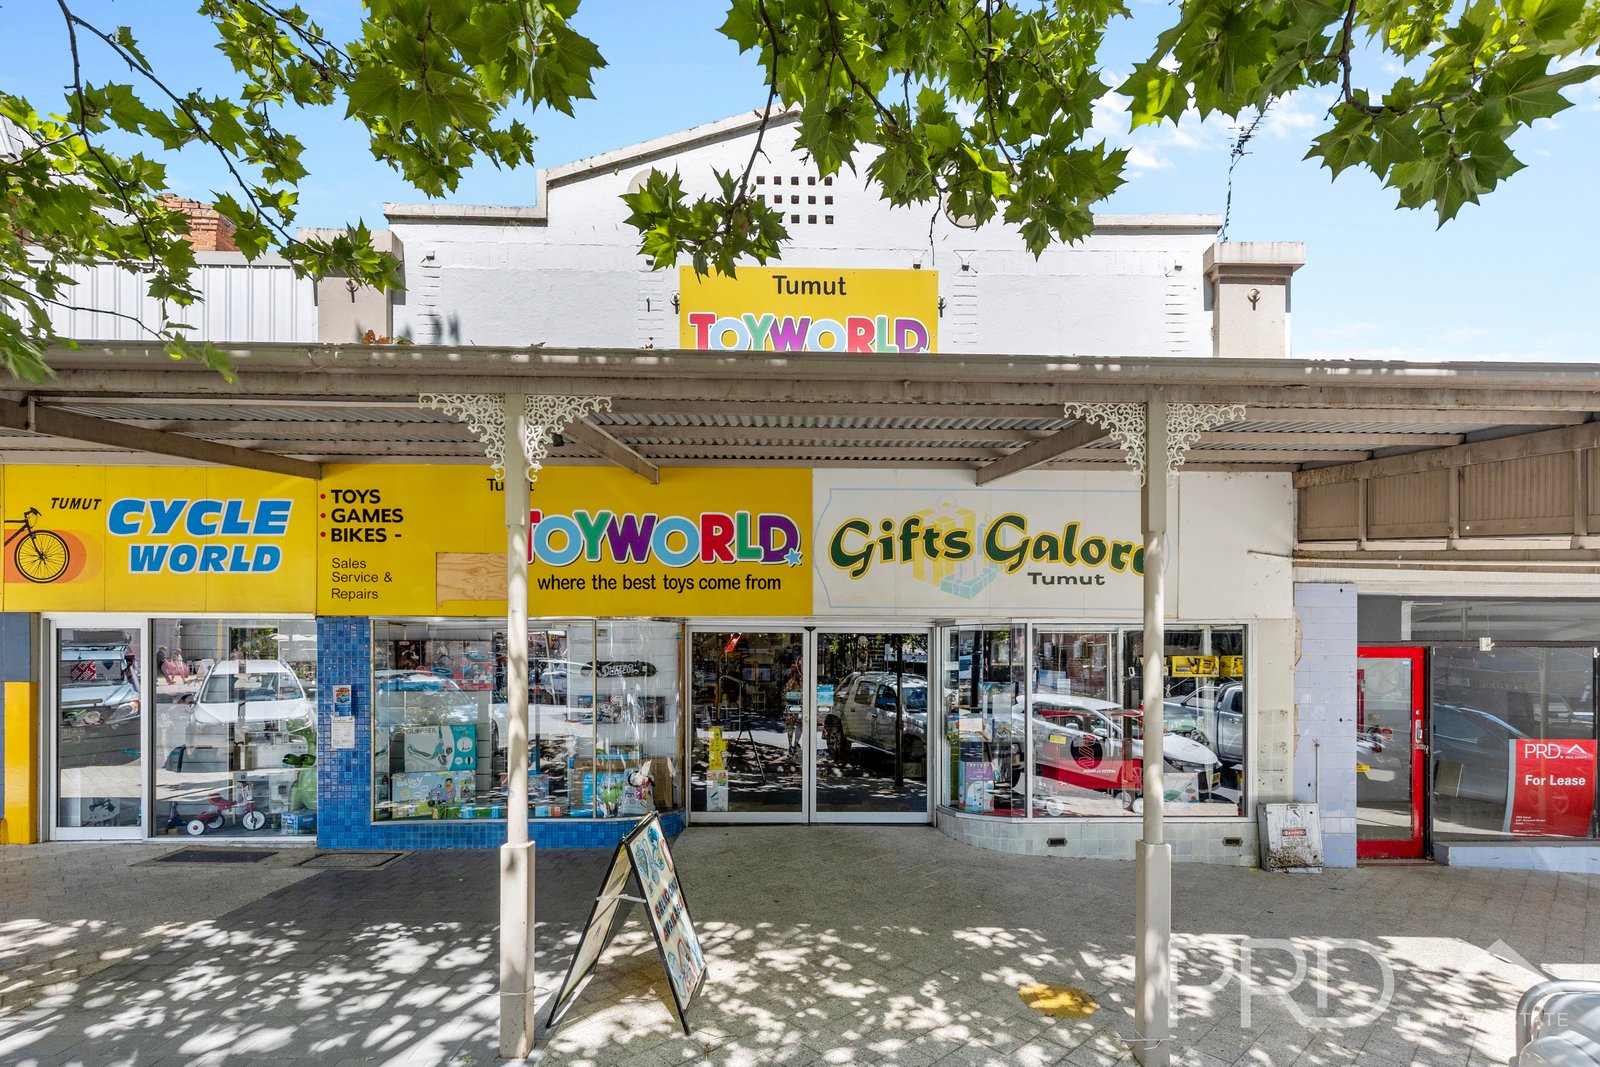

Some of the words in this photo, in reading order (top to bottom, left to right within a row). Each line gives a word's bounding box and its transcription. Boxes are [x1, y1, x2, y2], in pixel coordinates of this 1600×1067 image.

[772, 275, 847, 296] Tumut
[689, 312, 931, 354] TOYWORLD
[486, 478, 535, 492] Tut
[51, 497, 101, 511] TUMUT
[331, 489, 381, 504] TOYS
[107, 498, 294, 537] CYCLE
[331, 508, 404, 524] GAMES
[331, 528, 387, 543] BIKES
[828, 515, 974, 580] Gifts
[128, 543, 282, 574] WORLD
[332, 558, 367, 569] Sales
[331, 572, 379, 583] Service
[384, 573, 393, 583] &
[537, 575, 586, 591] where
[592, 574, 617, 590] the
[623, 574, 656, 590] best
[663, 575, 695, 594] toys
[699, 577, 741, 590] come
[746, 574, 782, 590] from
[1027, 572, 1105, 586] Tumut
[331, 588, 379, 600] Repairs
[1525, 774, 1546, 785] For
[1550, 774, 1586, 786] Lease
